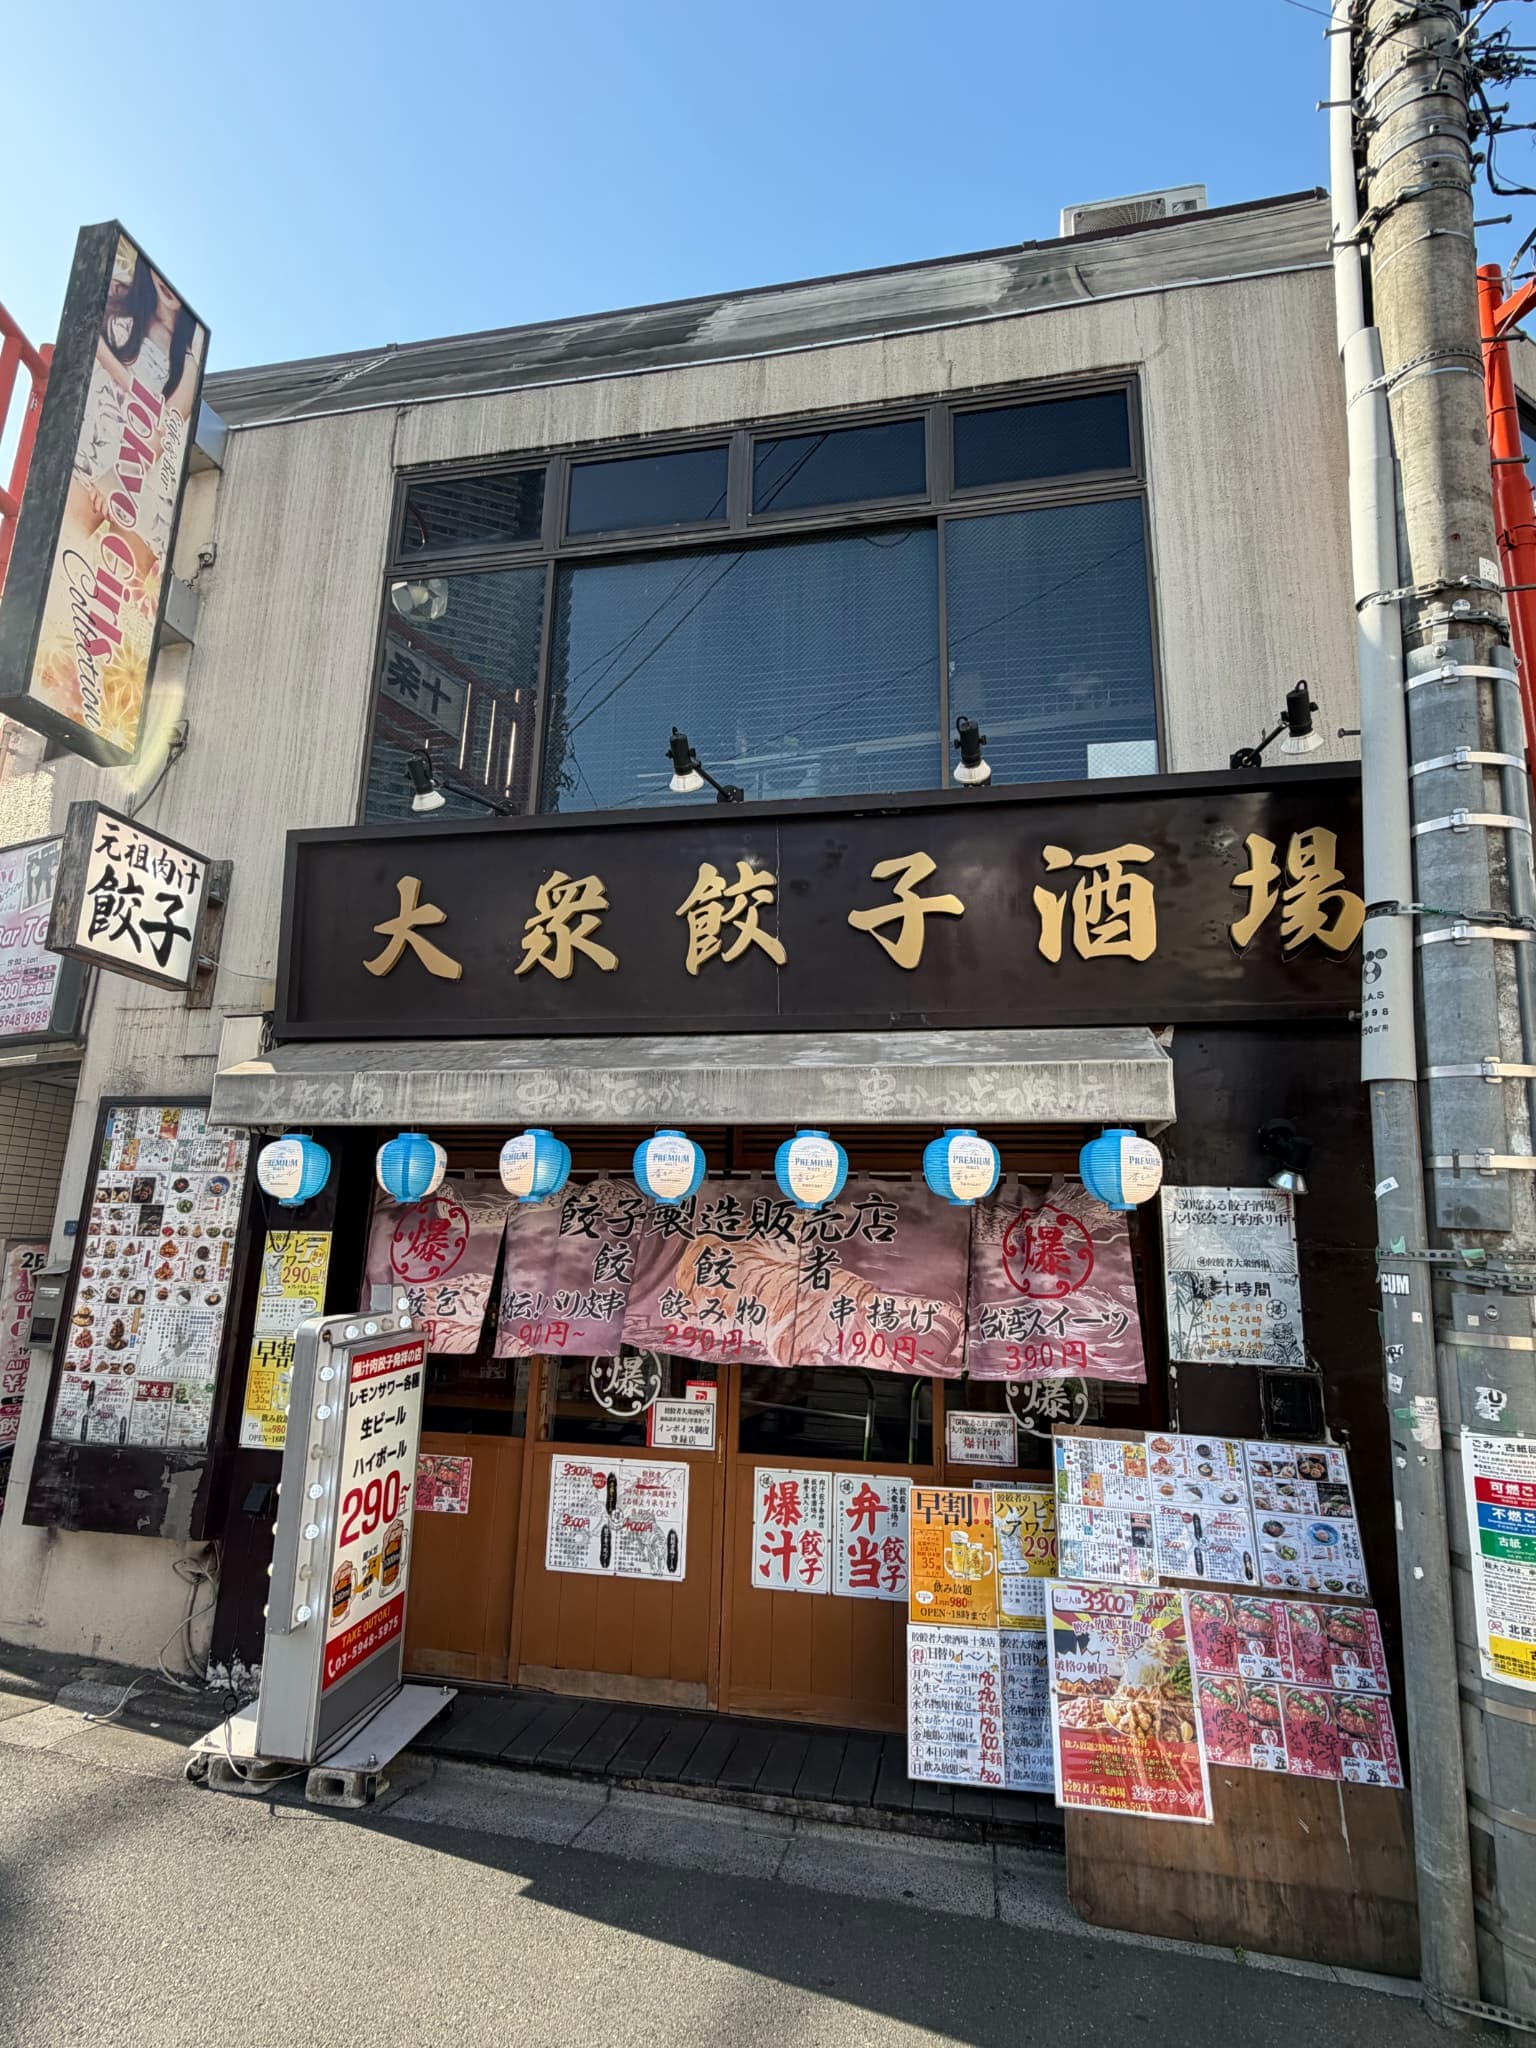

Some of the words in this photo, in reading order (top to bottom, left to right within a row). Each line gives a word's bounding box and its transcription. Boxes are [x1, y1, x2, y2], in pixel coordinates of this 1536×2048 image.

[110, 377, 165, 528] Tokyo
[84, 534, 137, 666] Girls
[62, 548, 102, 730] Collection
[95, 822, 201, 896] 元祖肉汁
[87, 863, 193, 969] 餃子
[362, 825, 1366, 981] 大衆餃子酒場
[652, 1153, 690, 1164] PREMIUM
[794, 1156, 833, 1168] PREMIUM
[952, 1154, 991, 1166] PREMIUM
[558, 1193, 899, 1243] 餃子製造販売店
[402, 1218, 453, 1263] 爆
[1021, 1223, 1073, 1276] 爆
[658, 1287, 768, 1327] 飲み物
[828, 1294, 944, 1334] 串揚げ
[977, 1304, 1130, 1342] 台湾スイーツ
[349, 1371, 420, 1409] レモンサワー各種
[603, 1355, 646, 1398] 爆
[1020, 1375, 1072, 1419] 爆
[360, 1405, 407, 1441] 生ビール
[352, 1439, 408, 1479] ハイボール
[759, 1479, 803, 1584] 爆汁
[845, 1481, 890, 1589] 弁当
[798, 1529, 824, 1586] 餃子
[880, 1536, 906, 1593] 餃子
[933, 1580, 973, 1597] 飲み放題
[334, 1614, 400, 1669] 03-5948-5975
[340, 1627, 362, 1649] TAKE
[1106, 1647, 1139, 1660] コース
[1054, 1659, 1109, 1675] 破格の値段
